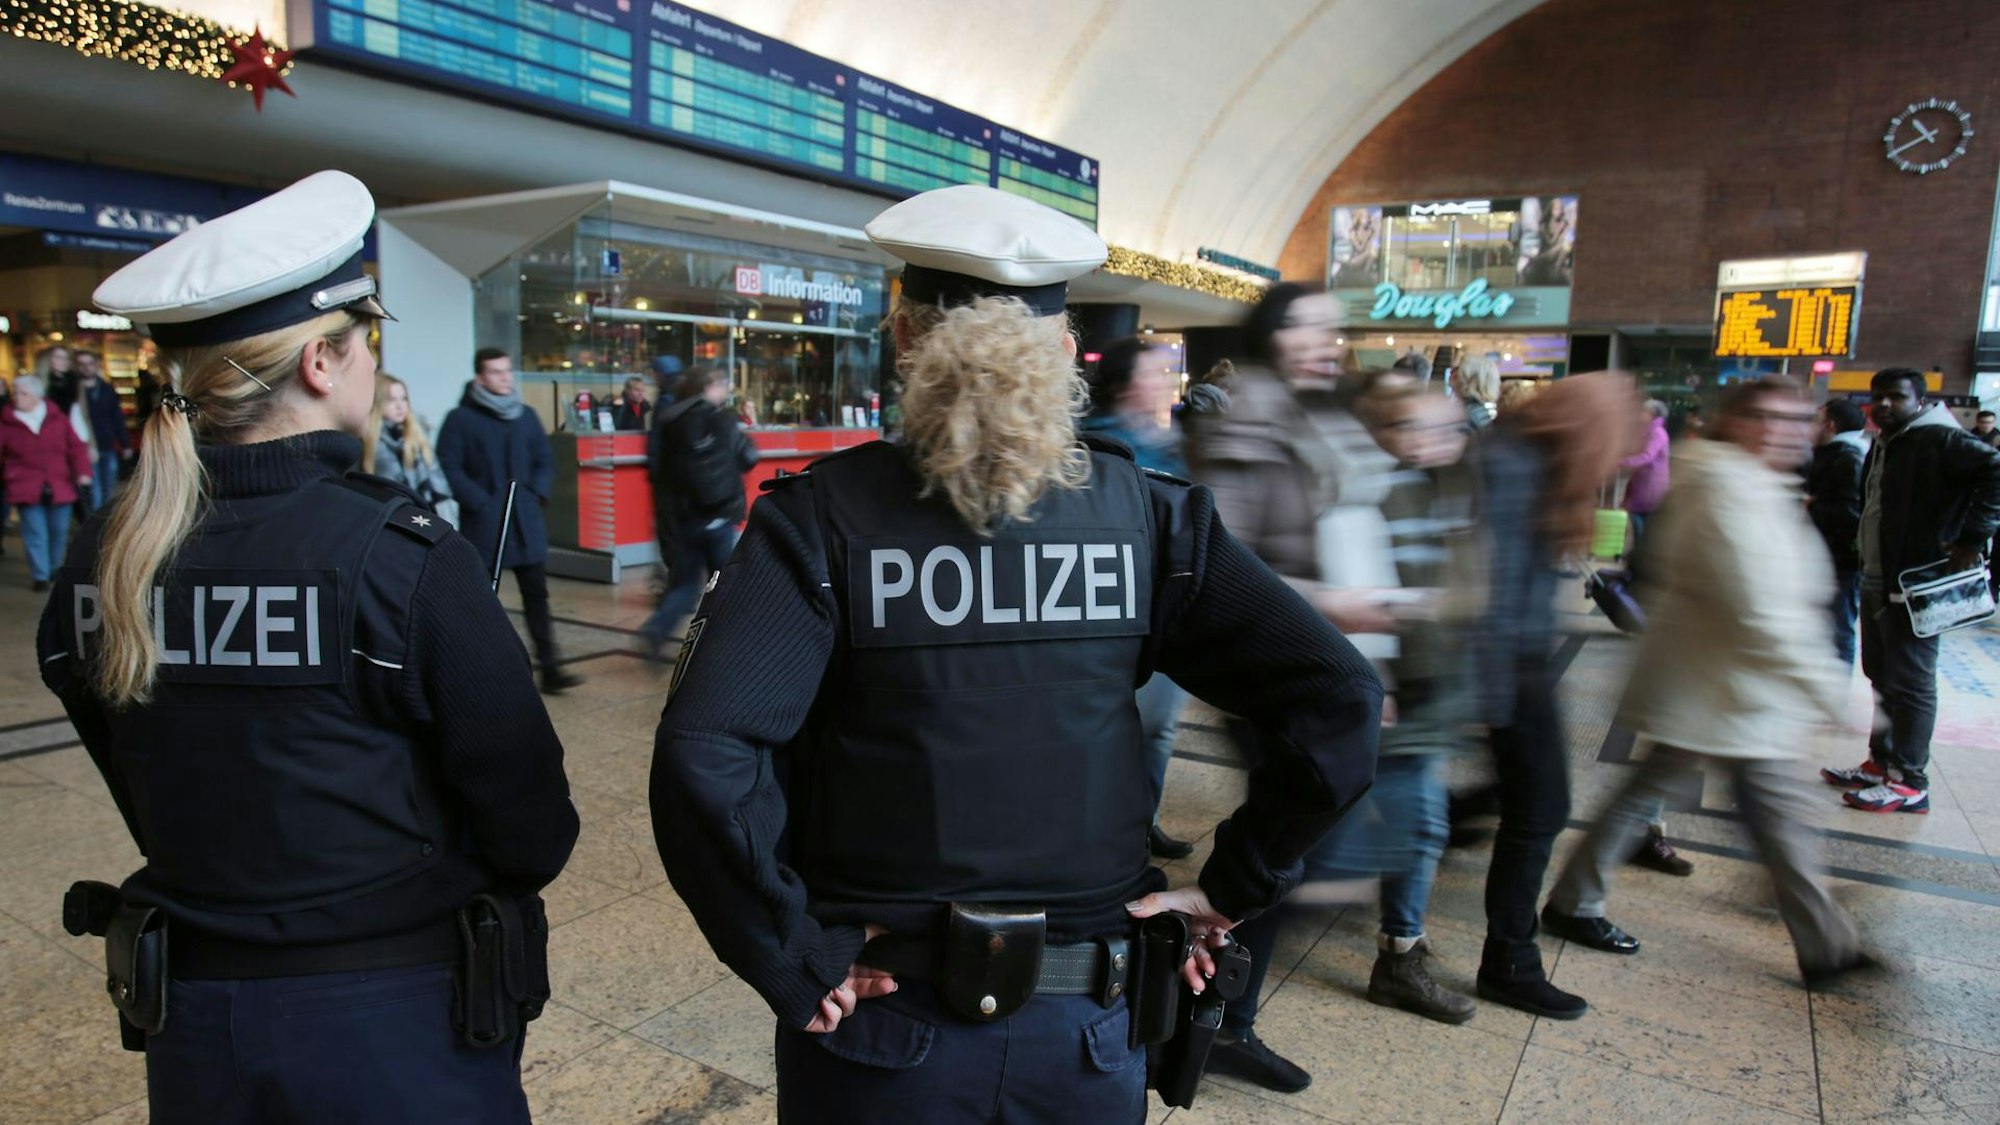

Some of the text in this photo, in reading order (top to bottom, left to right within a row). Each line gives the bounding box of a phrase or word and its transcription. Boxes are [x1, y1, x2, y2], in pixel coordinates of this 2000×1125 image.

[3, 192, 86, 214] ReiseZentrum
[738, 269, 863, 306] DB Information
[1369, 277, 1515, 330] Douglas
[870, 544, 1137, 628] POLIZEI
[73, 583, 322, 667] PLIZEI
